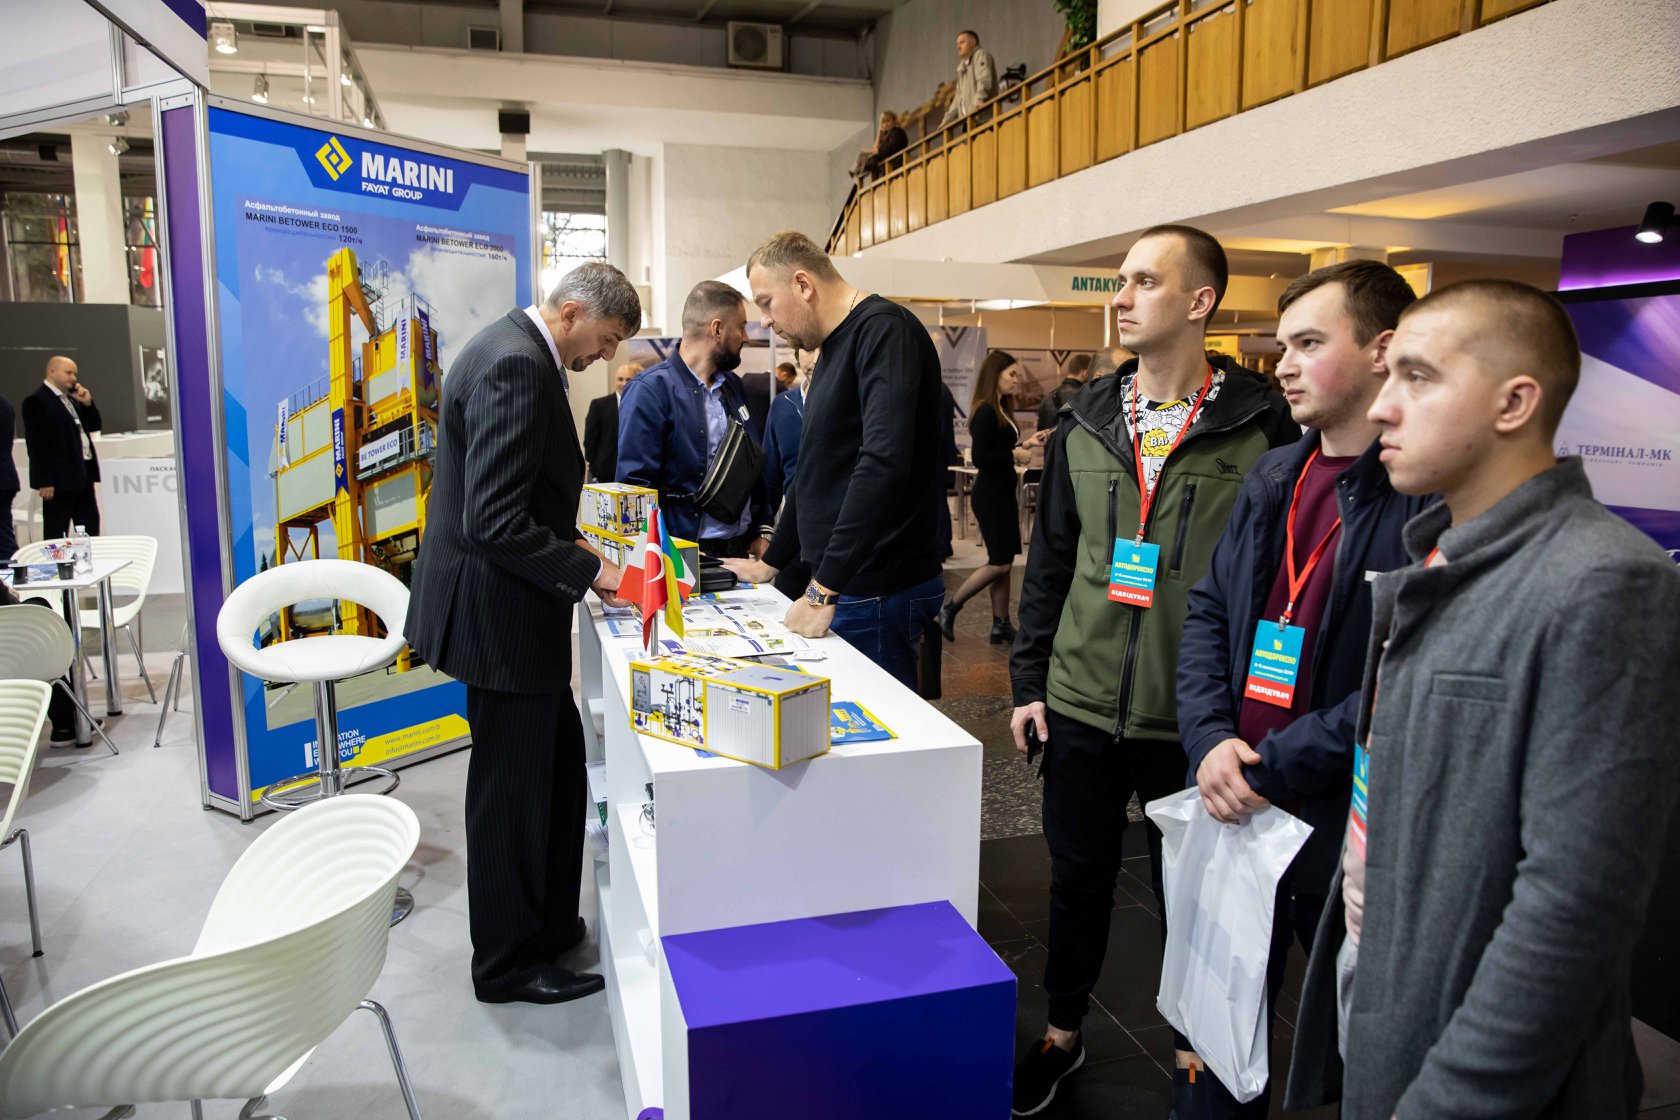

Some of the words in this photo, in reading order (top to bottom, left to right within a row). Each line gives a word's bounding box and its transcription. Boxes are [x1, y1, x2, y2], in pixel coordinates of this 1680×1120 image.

[361, 151, 454, 194] MARINI
[361, 181, 390, 195] FAYAT
[391, 187, 423, 201] GROUP
[244, 200, 319, 218] Асфальтобетонный
[319, 212, 341, 222] завод
[245, 212, 277, 224] MARINI
[278, 216, 320, 230] BETOWER
[322, 222, 339, 232] ECO
[341, 225, 358, 235] 1500
[416, 234, 440, 245] MARINI
[441, 237, 474, 249] BETOWER
[475, 242, 489, 251] ECO
[1072, 276, 1121, 292] ANTAKY
[334, 418, 342, 461] MARINI
[368, 445, 386, 458] TOWER
[386, 439, 398, 450] ECO
[1577, 444, 1672, 461] ТЕРМІНАЛ-МК
